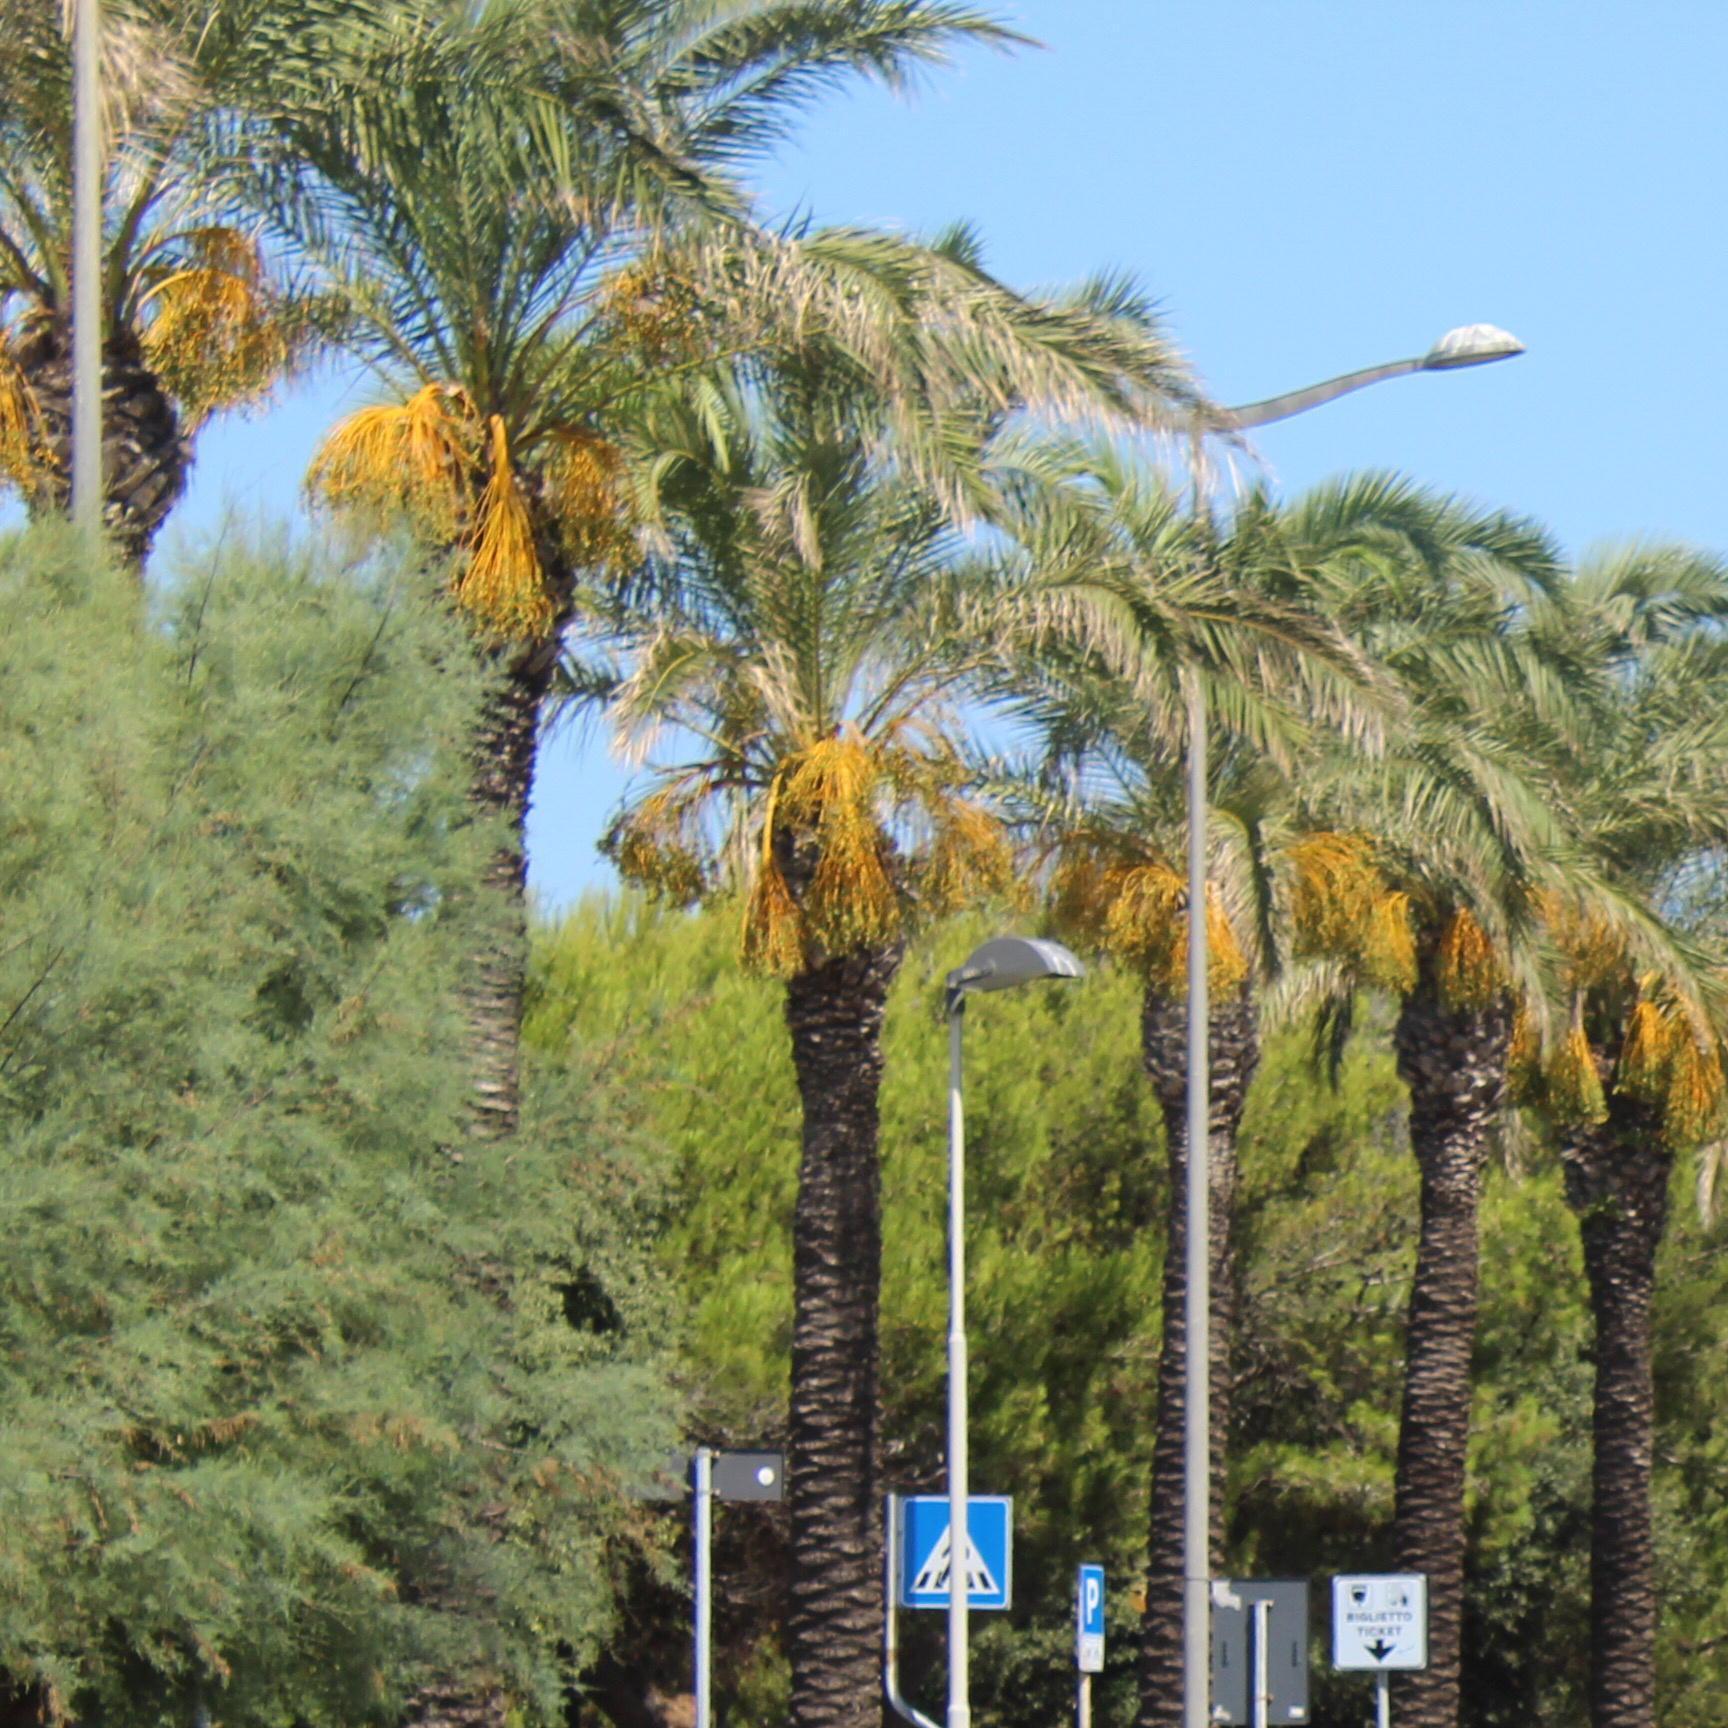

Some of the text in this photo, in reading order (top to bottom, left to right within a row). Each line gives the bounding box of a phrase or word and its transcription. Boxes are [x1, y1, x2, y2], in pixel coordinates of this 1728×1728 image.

[1086, 1577, 1099, 1625] P
[1346, 1612, 1413, 1622] BIGLIETTO
[1358, 1626, 1402, 1636] TICKET
